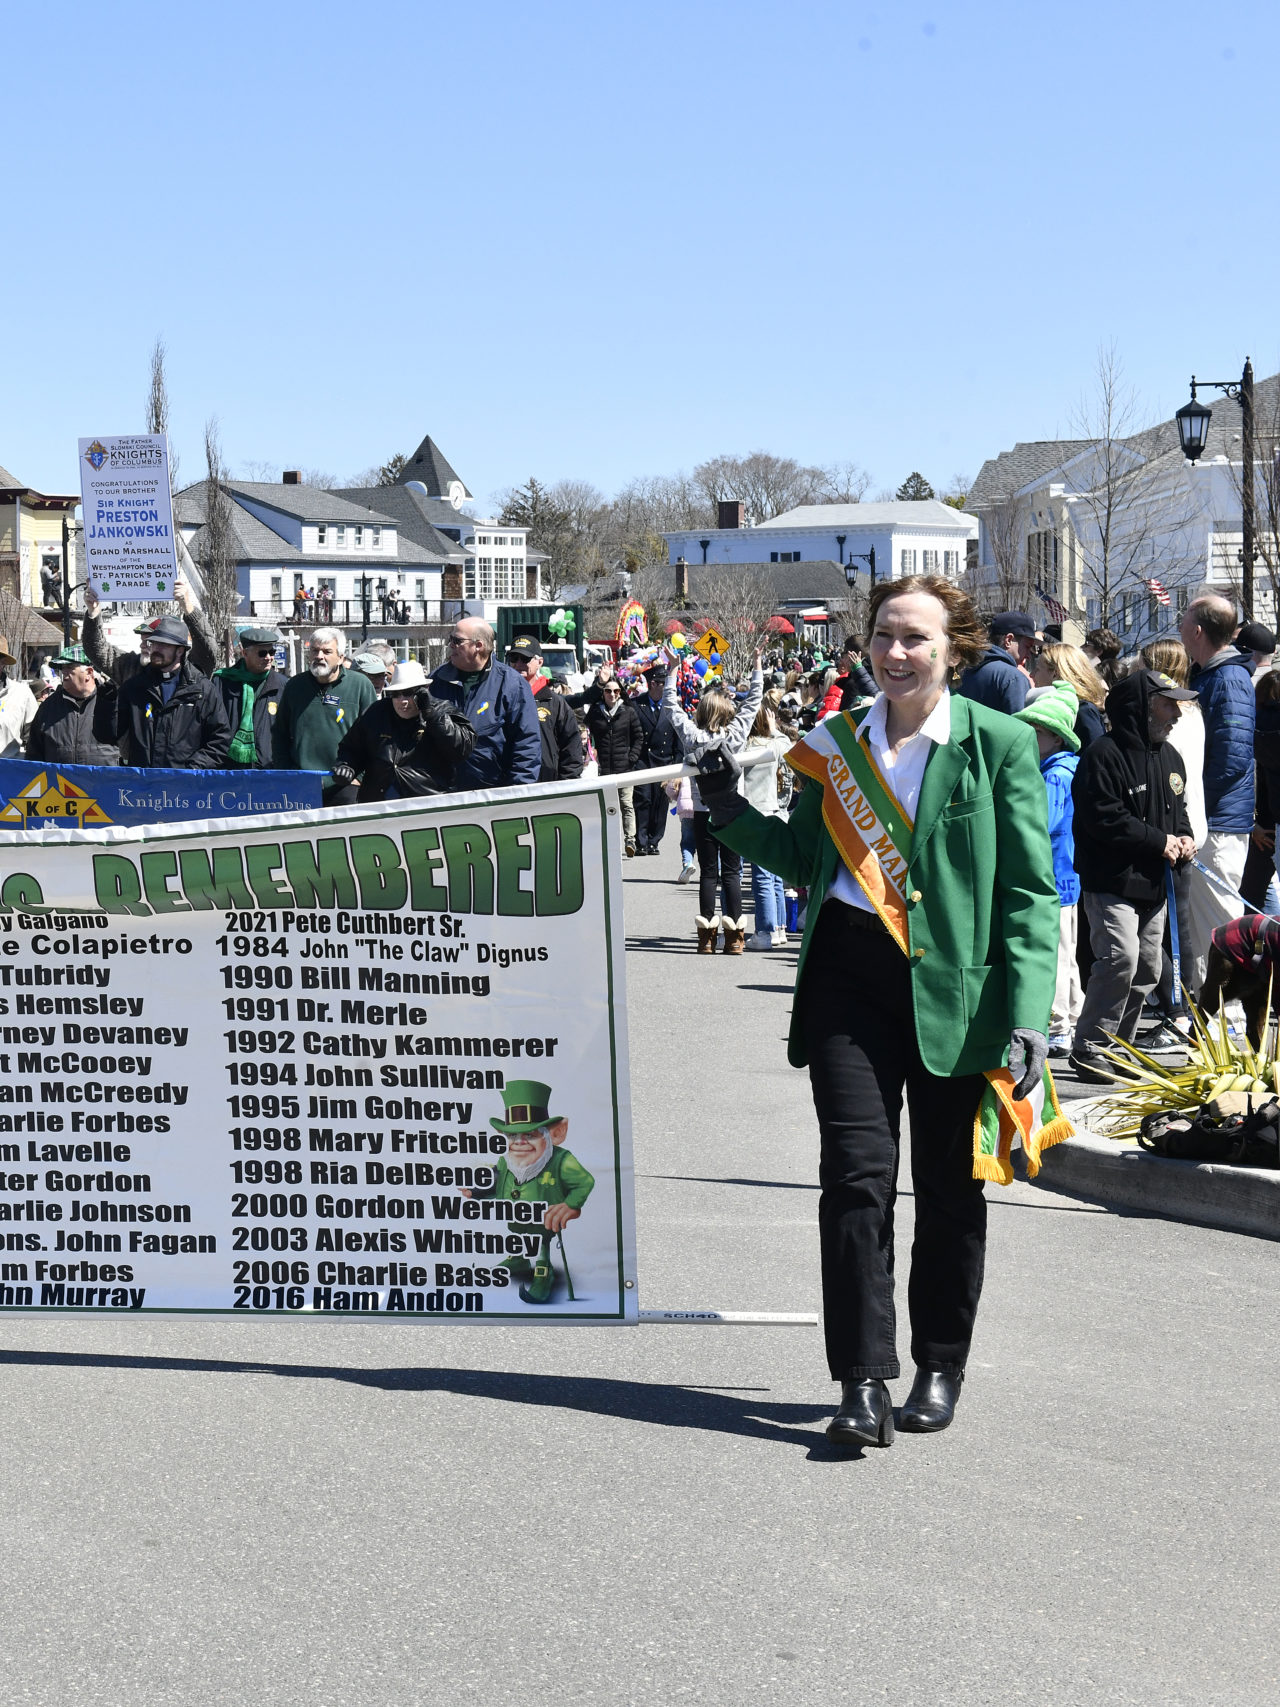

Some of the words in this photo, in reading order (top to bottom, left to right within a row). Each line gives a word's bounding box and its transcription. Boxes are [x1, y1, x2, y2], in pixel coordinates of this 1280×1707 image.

[111, 450, 161, 459] KNIGHTS
[98, 499, 114, 507] SIR
[118, 499, 155, 507] KNIGHT
[96, 510, 158, 523] PRESTON
[89, 525, 168, 538] JANKOWSKI
[118, 789, 189, 809] Knights
[196, 792, 213, 809] of
[220, 791, 312, 811] Columbus
[827, 753, 877, 831] GRAND
[27, 801, 38, 816] K
[46, 806, 59, 814] OF
[65, 801, 77, 816] C
[92, 812, 585, 918] REMEMBERED
[225, 911, 277, 933] 2021
[282, 910, 331, 934] Pete
[336, 911, 436, 936] Cuthbert
[439, 914, 466, 938] Sr.
[31, 933, 193, 960] Colapietro
[215, 935, 290, 958] 1984
[299, 937, 349, 959] John
[355, 938, 404, 961] "The
[410, 939, 469, 963] Claw"
[476, 943, 549, 969] Dignus
[219, 965, 293, 990] 1990
[300, 966, 351, 990] Bill
[358, 967, 491, 997] Manning
[15, 993, 144, 1017] Hemsley
[221, 997, 289, 1022] 1991
[296, 998, 334, 1023] Dr.
[340, 999, 428, 1026] Merle
[62, 1023, 189, 1047] Devaney
[223, 1030, 296, 1054] 1992
[302, 1031, 387, 1059] Cathy
[394, 1034, 559, 1058] Kammerer
[17, 1052, 152, 1076] McCooey
[224, 1062, 298, 1086] 1994
[304, 1063, 374, 1087] John
[379, 1064, 504, 1090] Sullivan
[40, 1081, 189, 1106] McCreedy
[71, 1111, 171, 1133] Forbes
[226, 1094, 300, 1119] 1995
[307, 1095, 357, 1119] Jim
[364, 1095, 473, 1125] Gohery
[27, 1140, 131, 1163] Lavelle
[228, 1127, 302, 1152] 1998
[308, 1128, 384, 1155] Mary
[391, 1128, 507, 1155] Fritchie
[45, 1170, 151, 1193] Gordon
[69, 1200, 191, 1223] Johnson
[231, 1193, 308, 1218] 2000
[315, 1194, 425, 1219] Gordon
[430, 1195, 547, 1223] Werner
[54, 1230, 122, 1253] John
[129, 1231, 217, 1256] Fagan
[232, 1226, 308, 1252] 2003
[315, 1227, 407, 1253] Alexis
[412, 1228, 541, 1258] Whitney
[35, 1260, 134, 1283] Forbes
[40, 1283, 146, 1309] Murray
